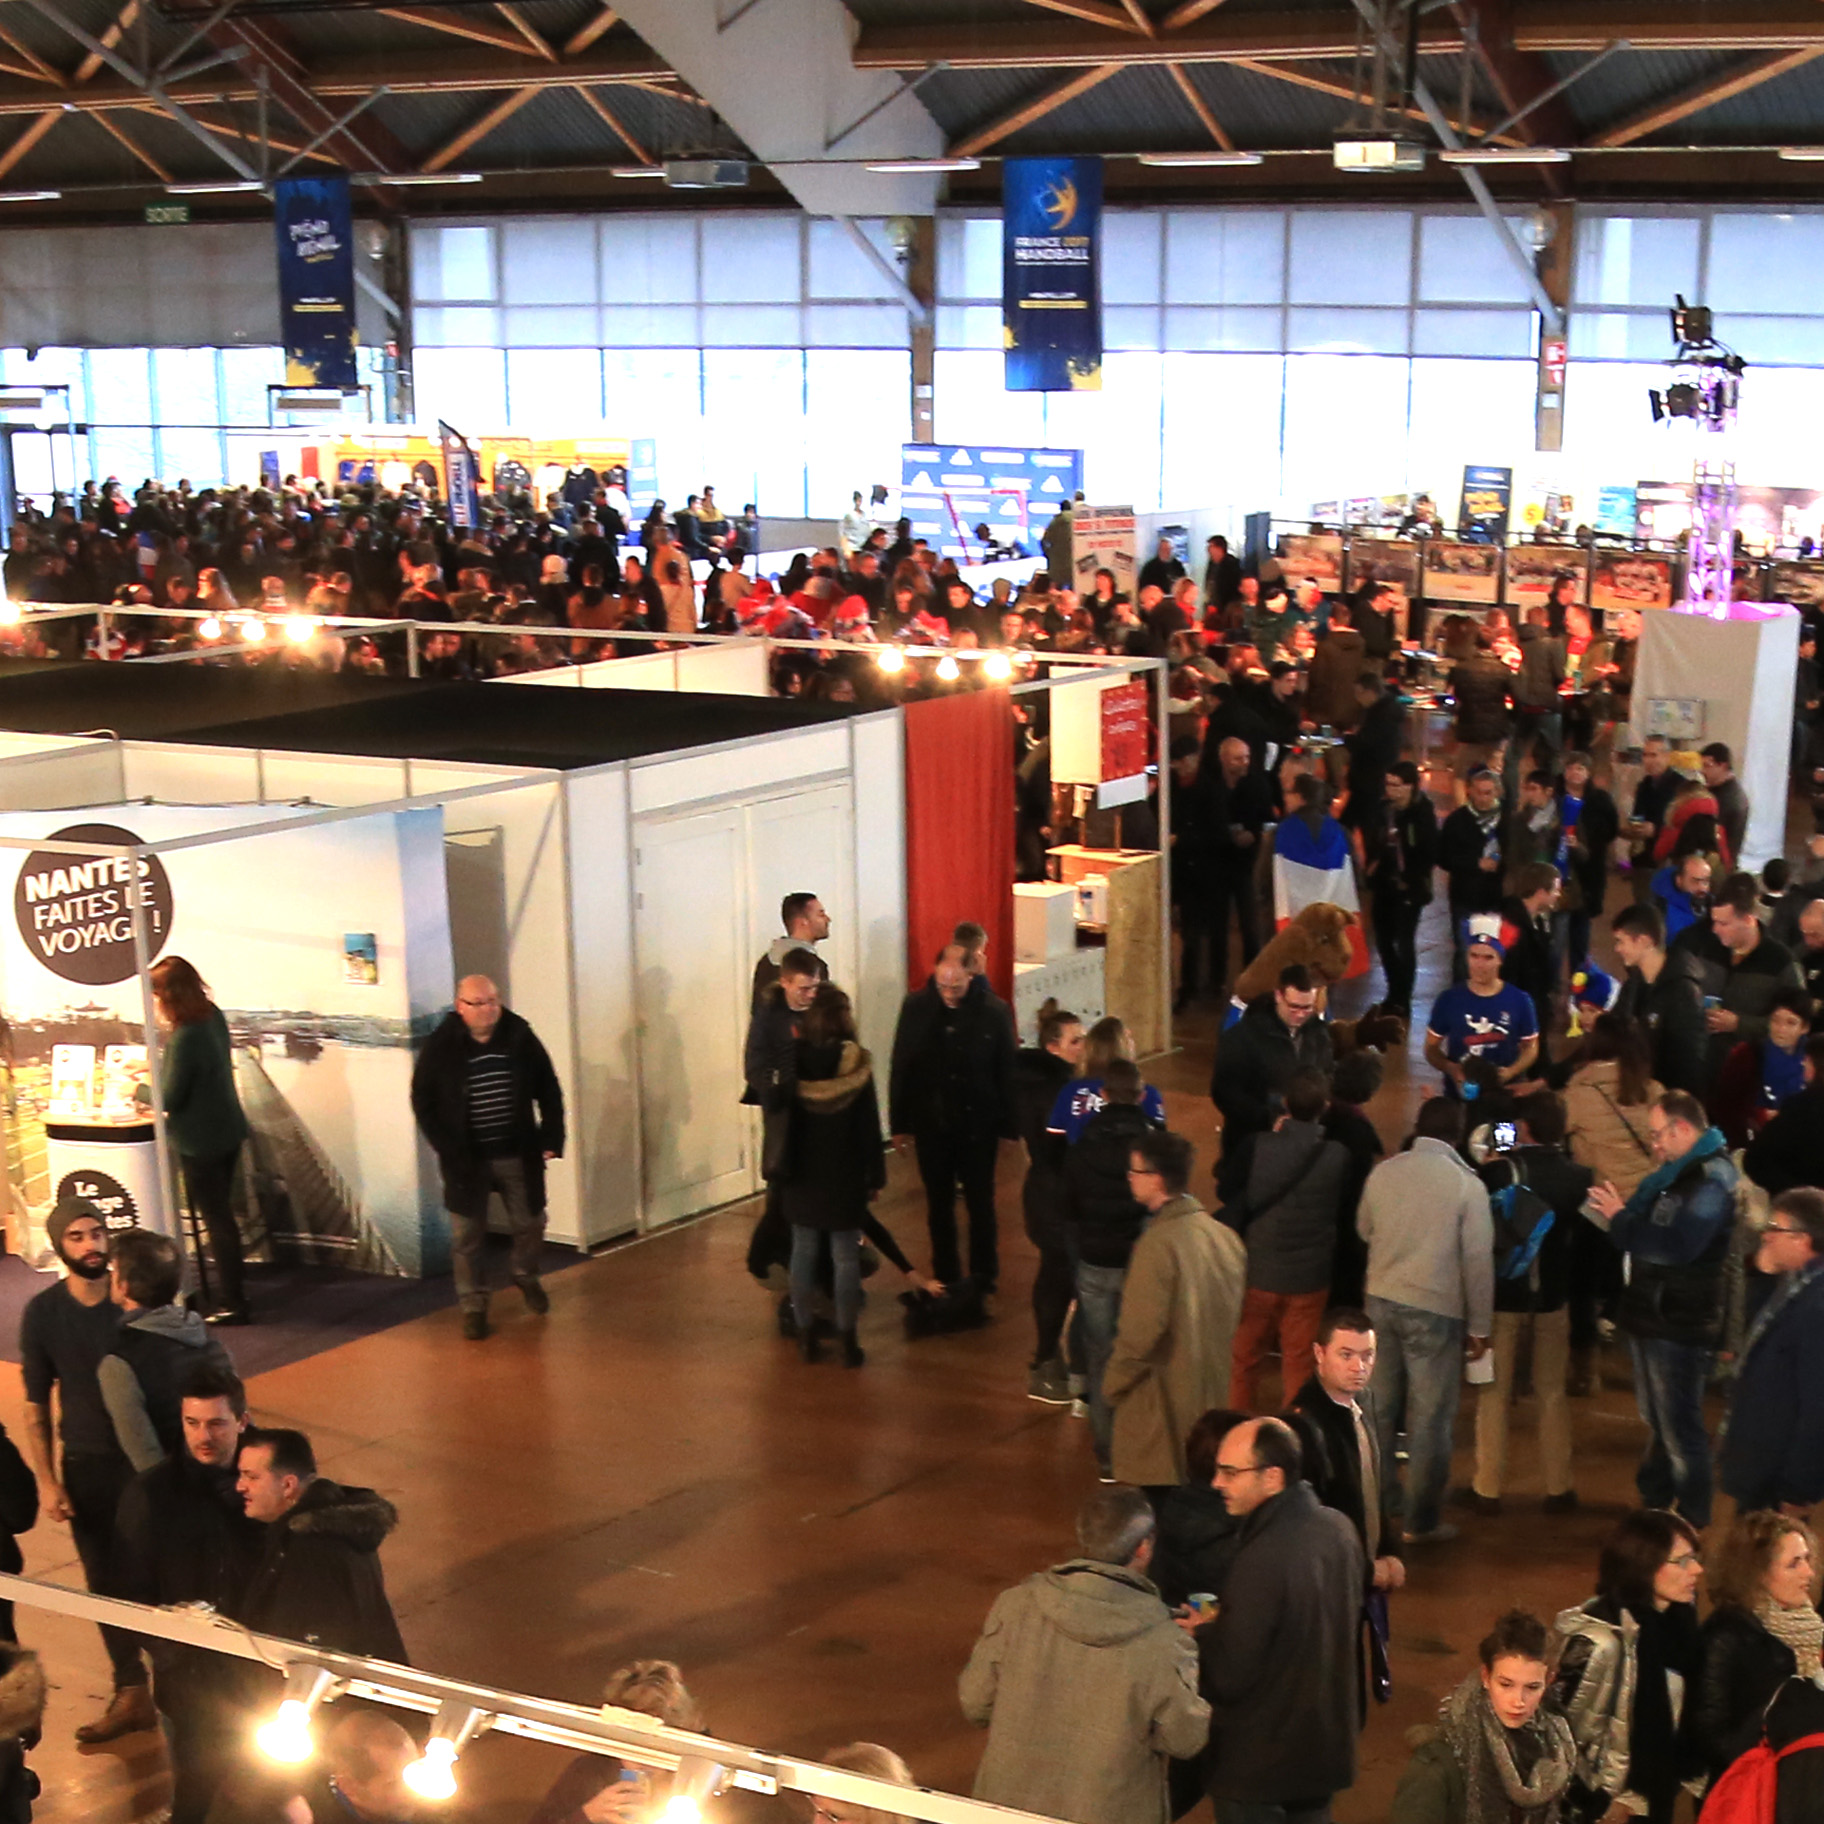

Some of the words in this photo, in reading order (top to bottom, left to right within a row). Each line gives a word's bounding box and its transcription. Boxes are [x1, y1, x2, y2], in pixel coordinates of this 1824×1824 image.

[24, 855, 151, 903] NANTES
[34, 889, 120, 931] FAITES
[125, 881, 156, 909] LE
[38, 917, 138, 957] VOYAG
[74, 1181, 99, 1197] Le
